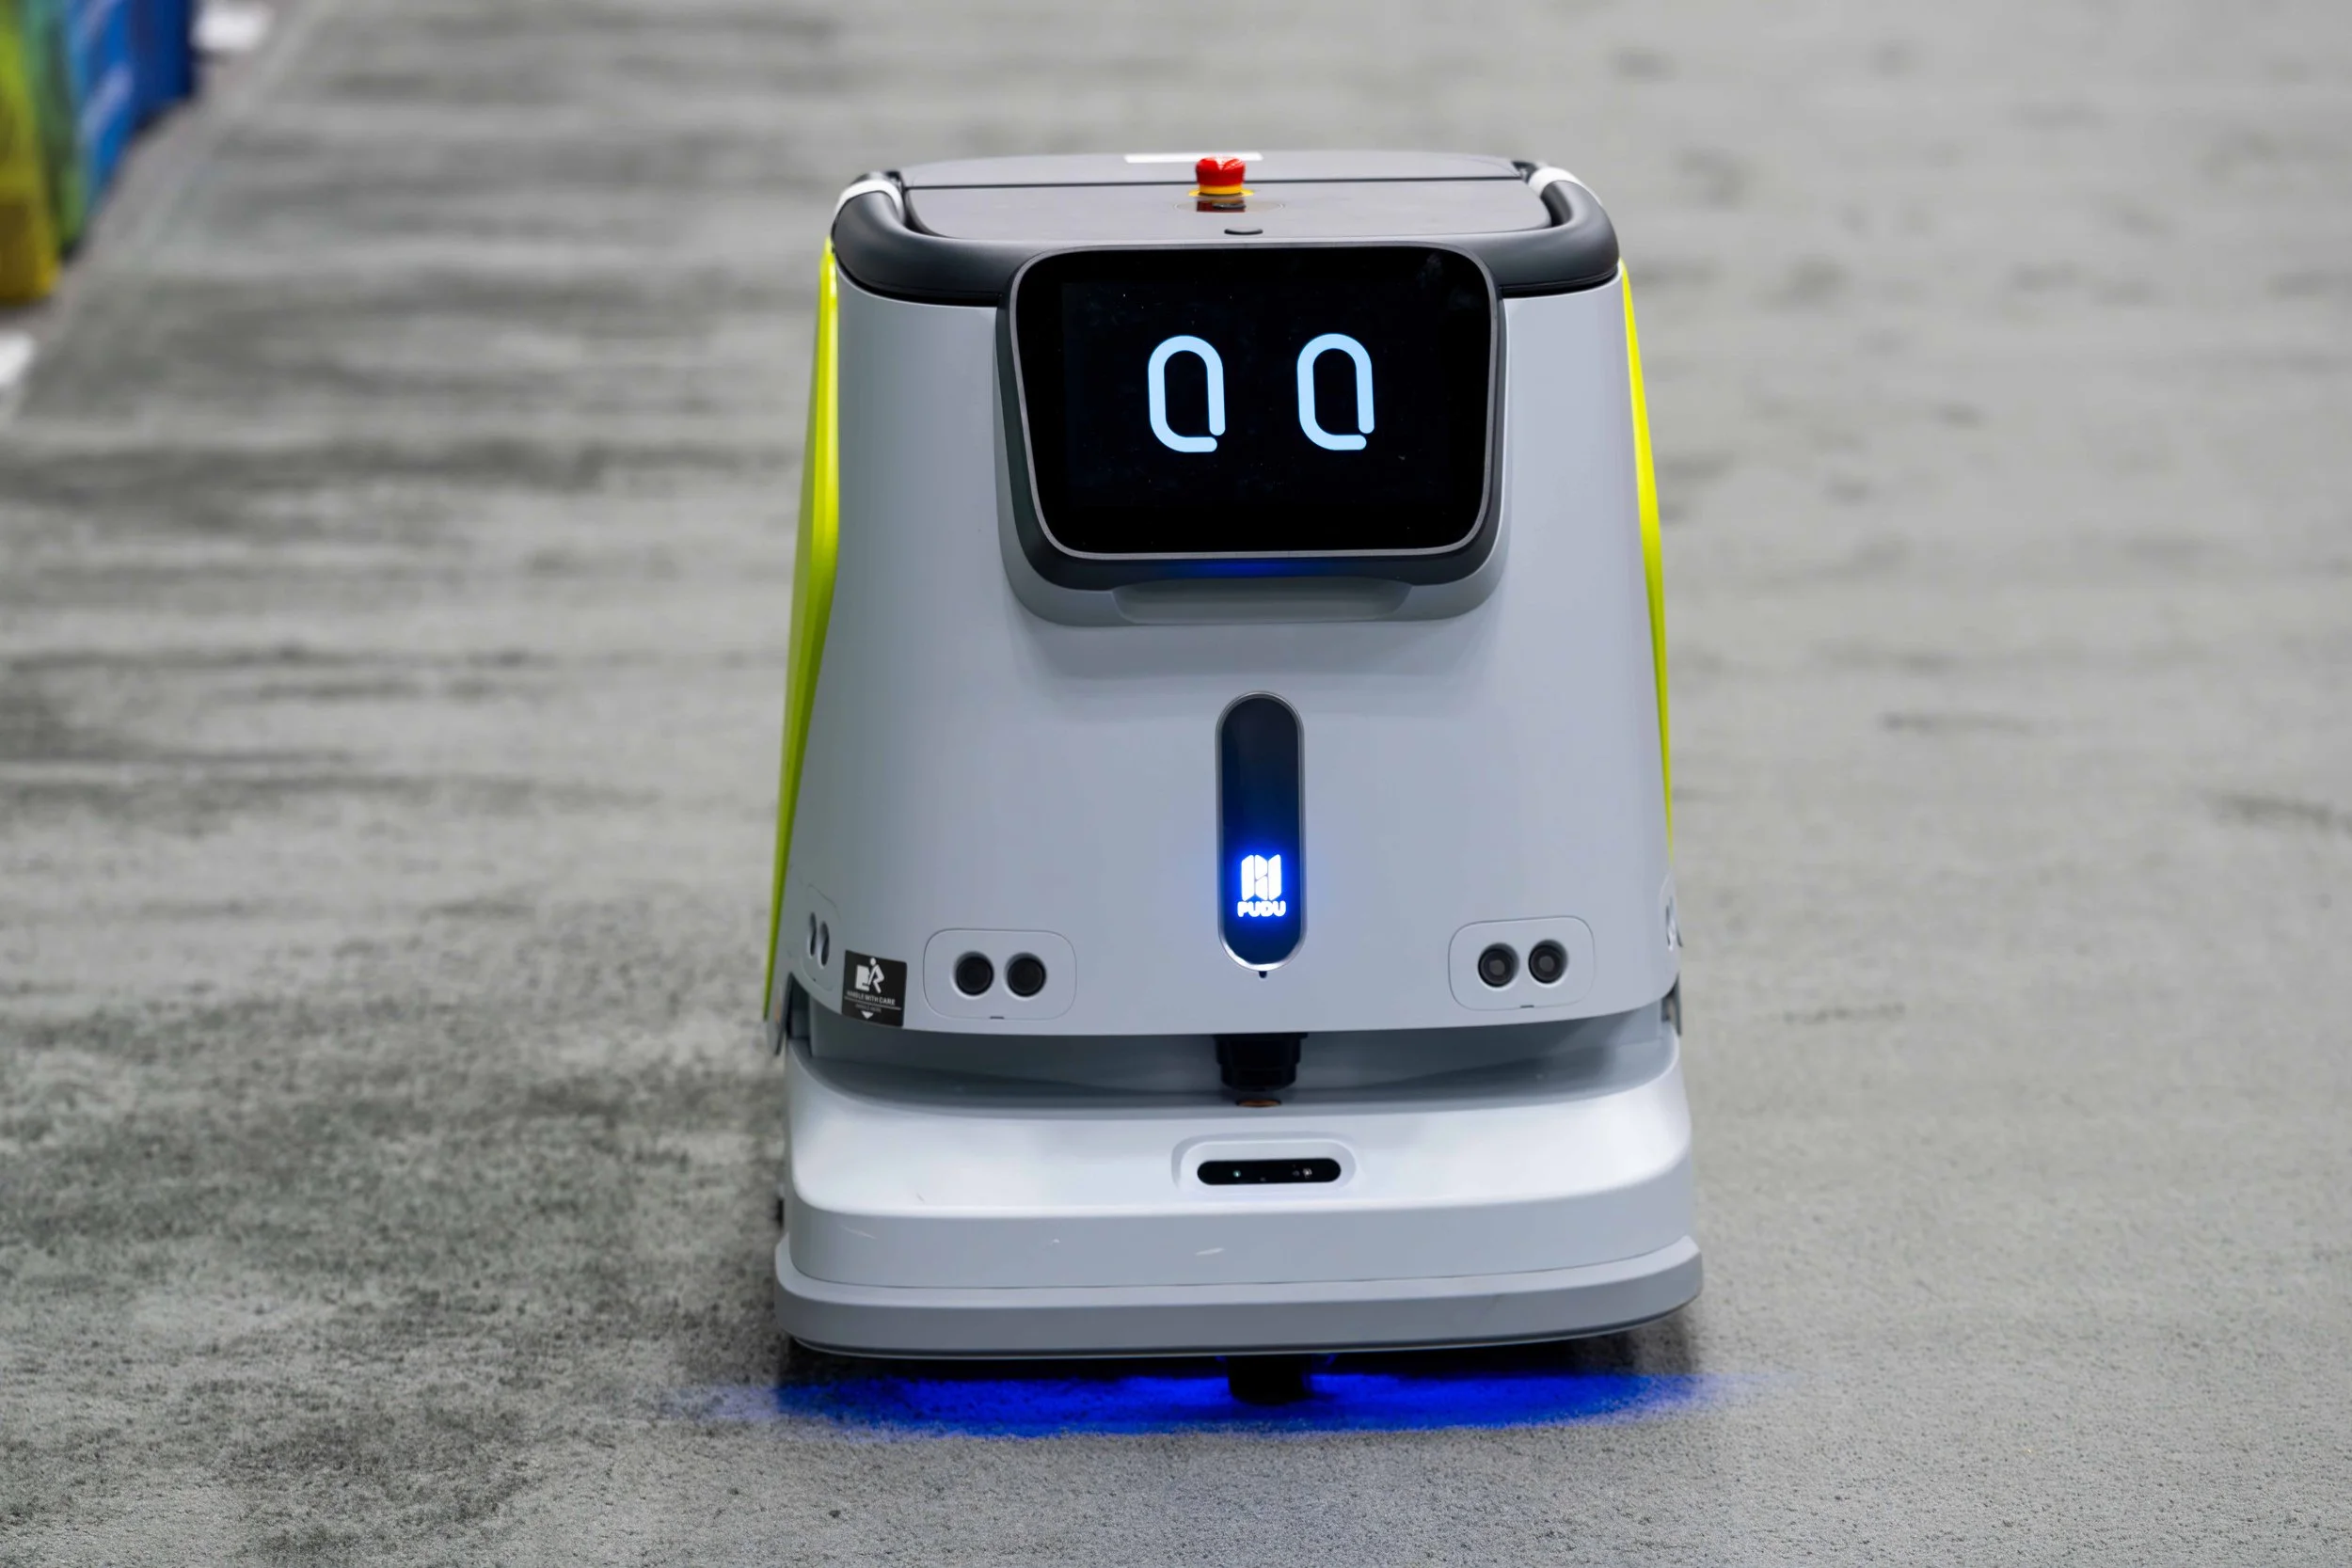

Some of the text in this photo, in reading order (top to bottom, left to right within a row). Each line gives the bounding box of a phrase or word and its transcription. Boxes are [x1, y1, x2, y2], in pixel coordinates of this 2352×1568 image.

[1237, 900, 1286, 917] PUDU
[866, 993, 879, 1003] WITH
[879, 997, 896, 1006] CARE
